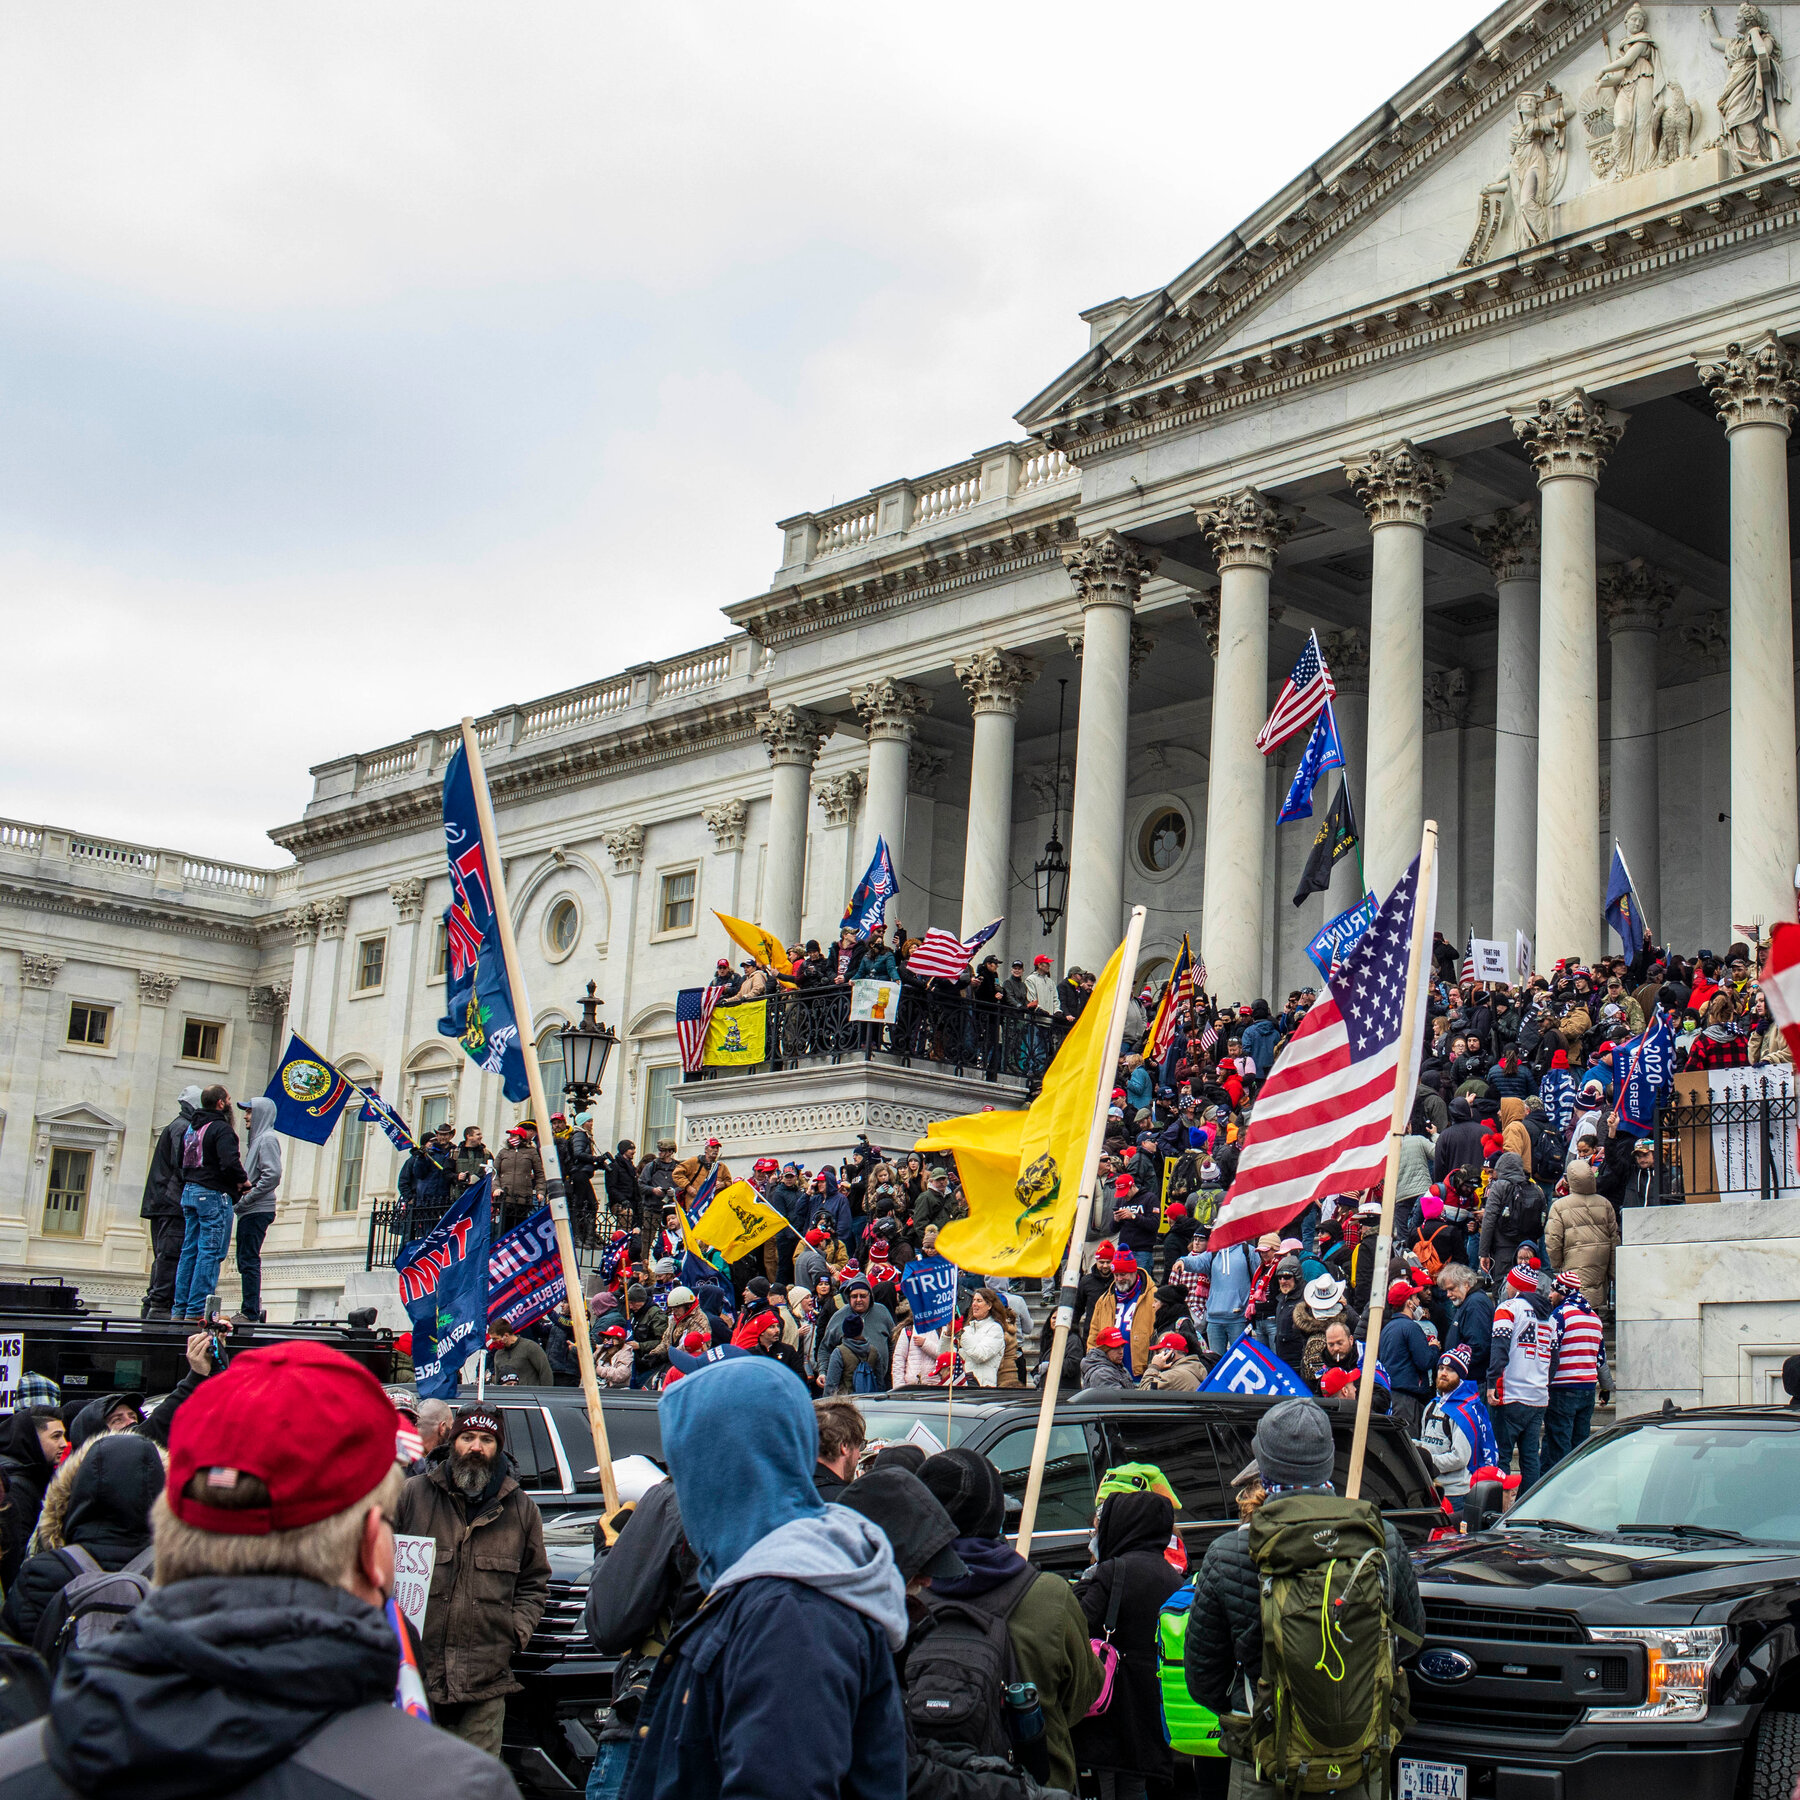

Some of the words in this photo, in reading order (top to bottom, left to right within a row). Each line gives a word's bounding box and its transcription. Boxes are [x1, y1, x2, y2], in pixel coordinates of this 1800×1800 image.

[1587, 106, 1608, 121] USA
[933, 1303, 954, 1315] AMERIC
[463, 1415, 498, 1431] TRUMP
[395, 1541, 433, 1581] ESS,
[1419, 1771, 1458, 1797] 1614X
